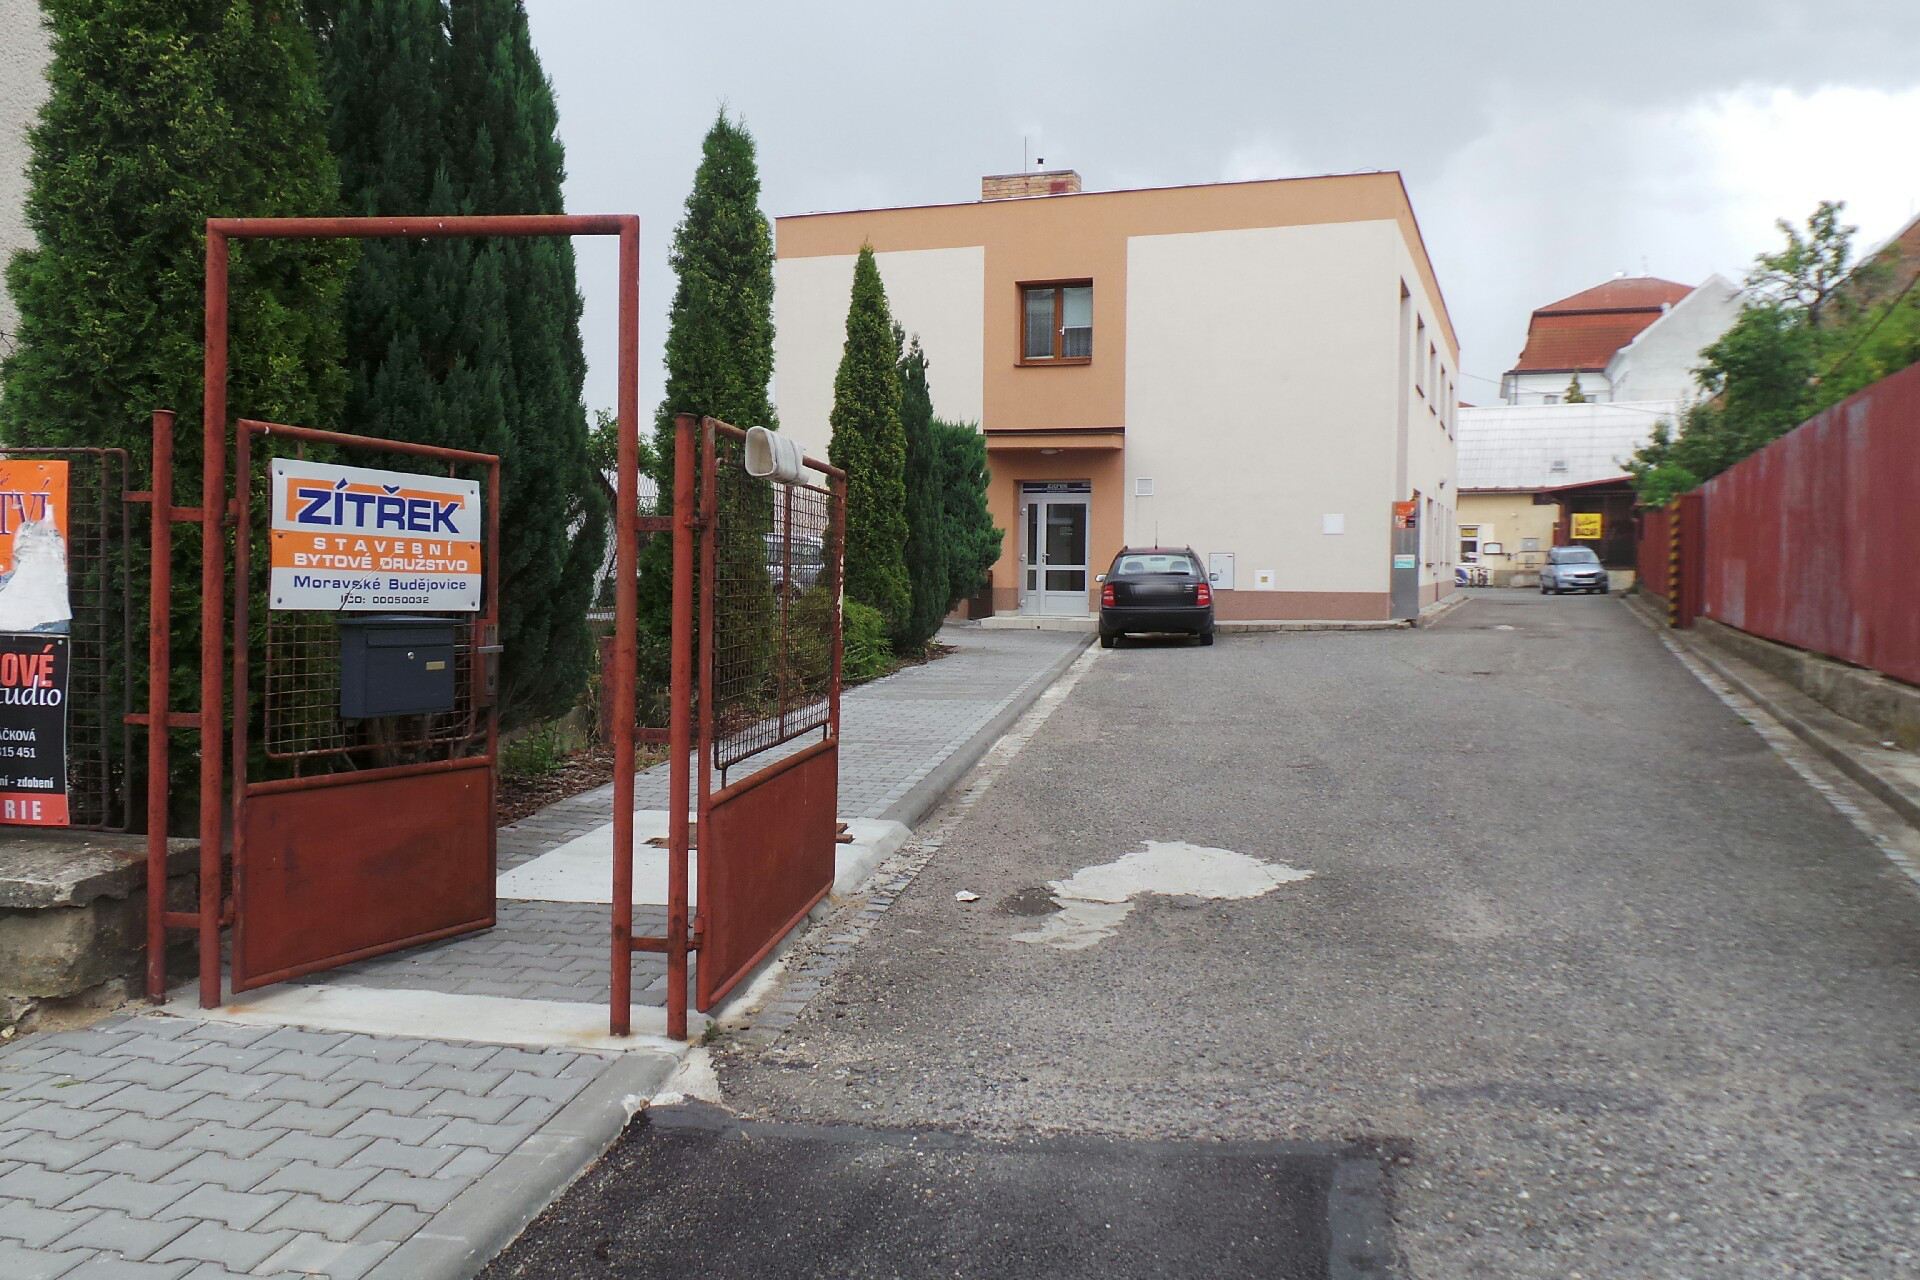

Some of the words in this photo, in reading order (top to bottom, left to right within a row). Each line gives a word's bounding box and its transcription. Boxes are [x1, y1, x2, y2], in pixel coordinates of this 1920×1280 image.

[298, 478, 460, 534] ZÍTŘEK
[313, 537, 452, 556] STAVEBNÍ
[294, 552, 372, 568] BYTOVÉ
[379, 555, 468, 571] DRUŽSTVO
[293, 575, 381, 590] Moravské
[388, 578, 467, 593] Budějovice
[372, 595, 430, 604] 00050032
[0, 643, 54, 687] OVÉ
[16, 747, 36, 758] 451
[17, 776, 54, 789] zdobení
